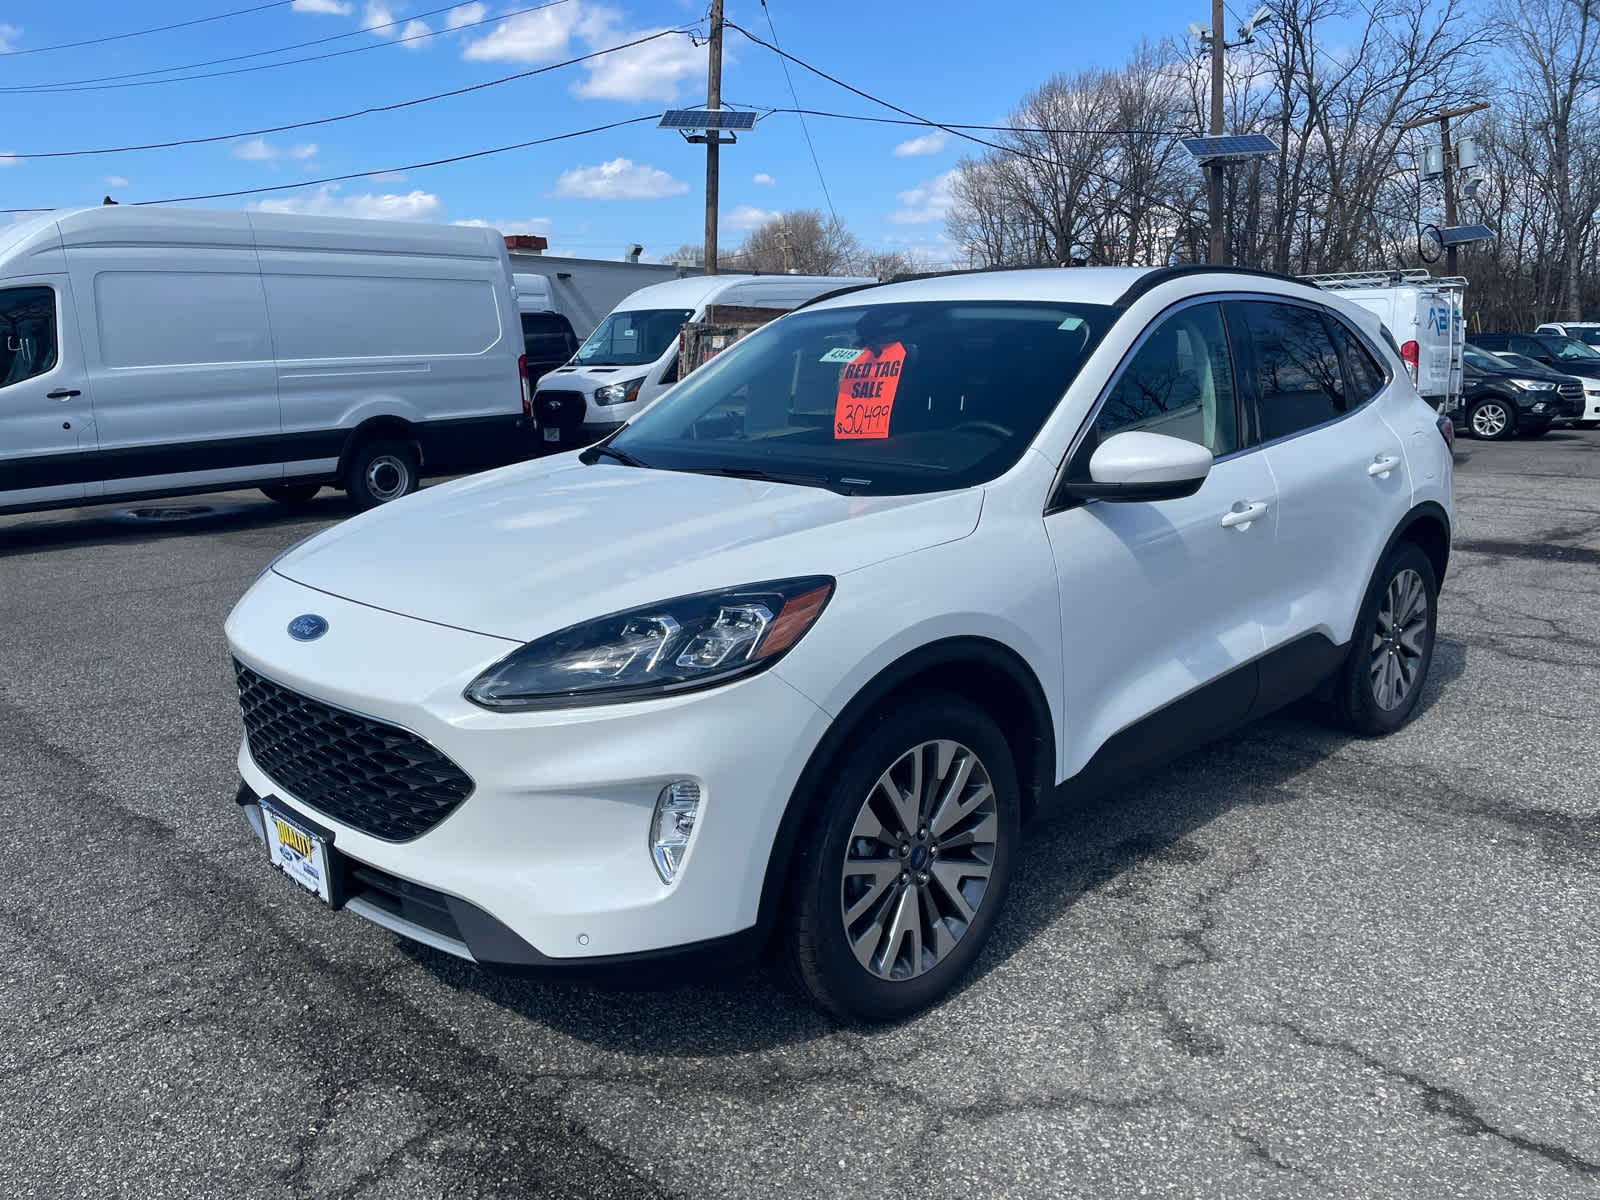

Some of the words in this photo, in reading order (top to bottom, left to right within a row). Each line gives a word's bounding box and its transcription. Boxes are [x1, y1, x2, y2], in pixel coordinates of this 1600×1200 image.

[845, 362, 873, 379] RED
[874, 360, 901, 378] TAG
[851, 381, 885, 399] SALE
[276, 819, 313, 863] QUALITY
